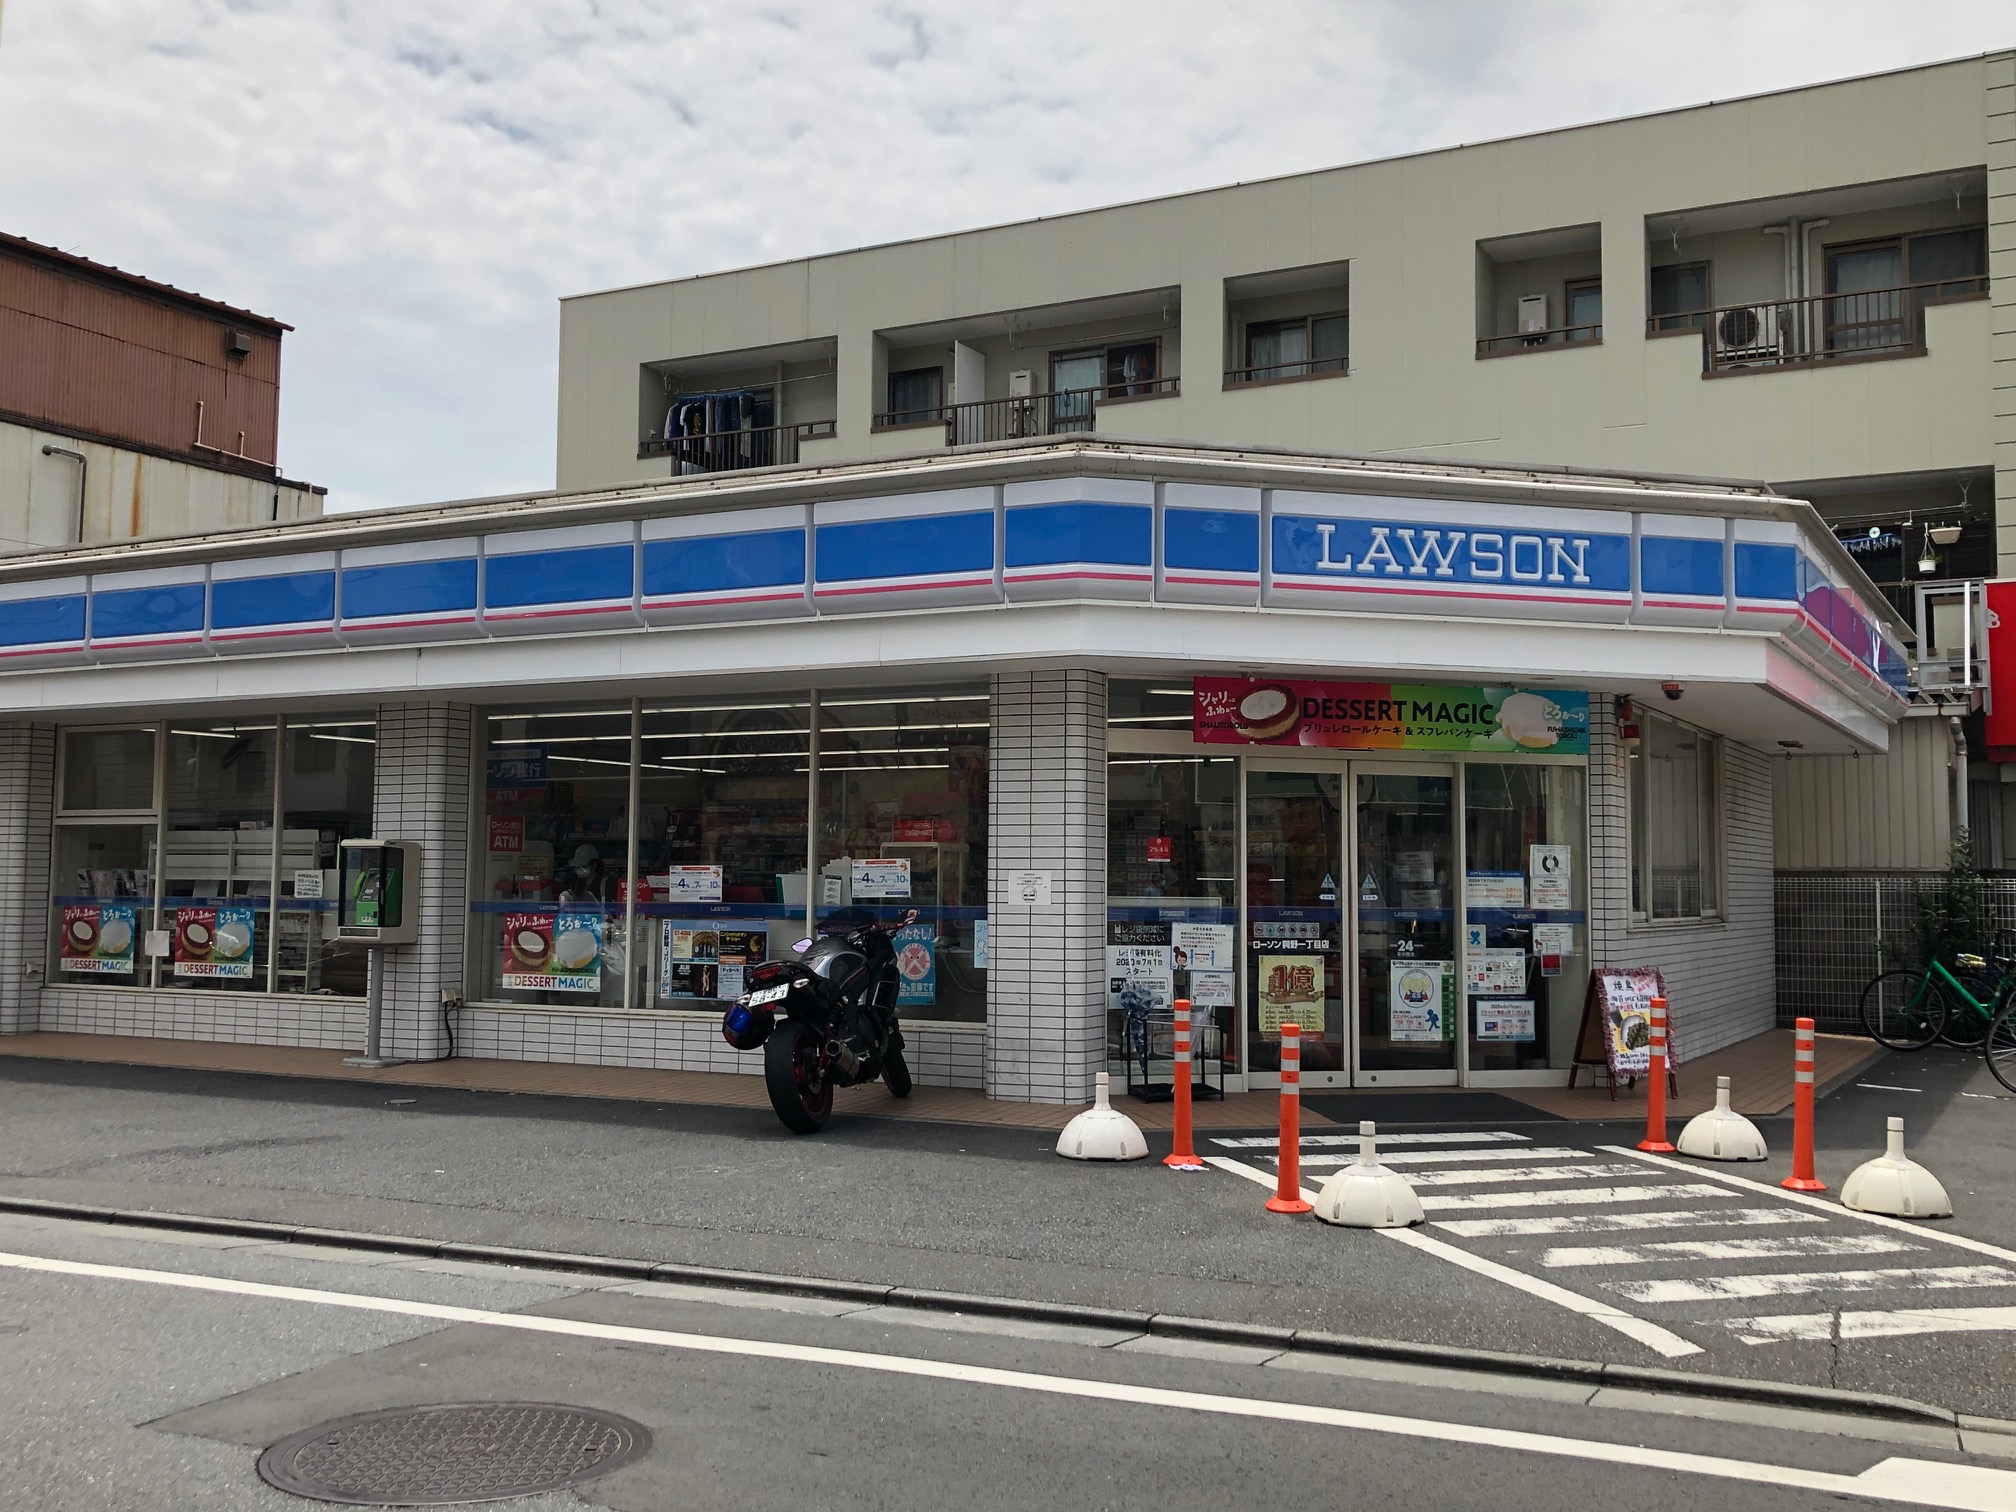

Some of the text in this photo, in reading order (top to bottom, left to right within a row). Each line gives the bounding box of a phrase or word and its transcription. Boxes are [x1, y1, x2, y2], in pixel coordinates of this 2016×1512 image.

[1317, 523, 1592, 584] LAWSON
[1303, 697, 1494, 726] DESSERT MAGIC
[1303, 723, 1401, 736] ブリュレロールケーキ
[1405, 726, 1414, 736] &
[495, 790, 518, 802] ATM
[494, 836, 518, 848] ATM
[1114, 934, 1165, 943] ご協力ください
[1397, 939, 1415, 952] 24
[70, 960, 128, 971] DESSERT MAGIC
[1116, 958, 1163, 967] 2020年7月1日
[184, 964, 248, 976] DESSERT MAGIC
[1125, 968, 1153, 976] スタート
[514, 975, 594, 989] DESSERT MAGIC
